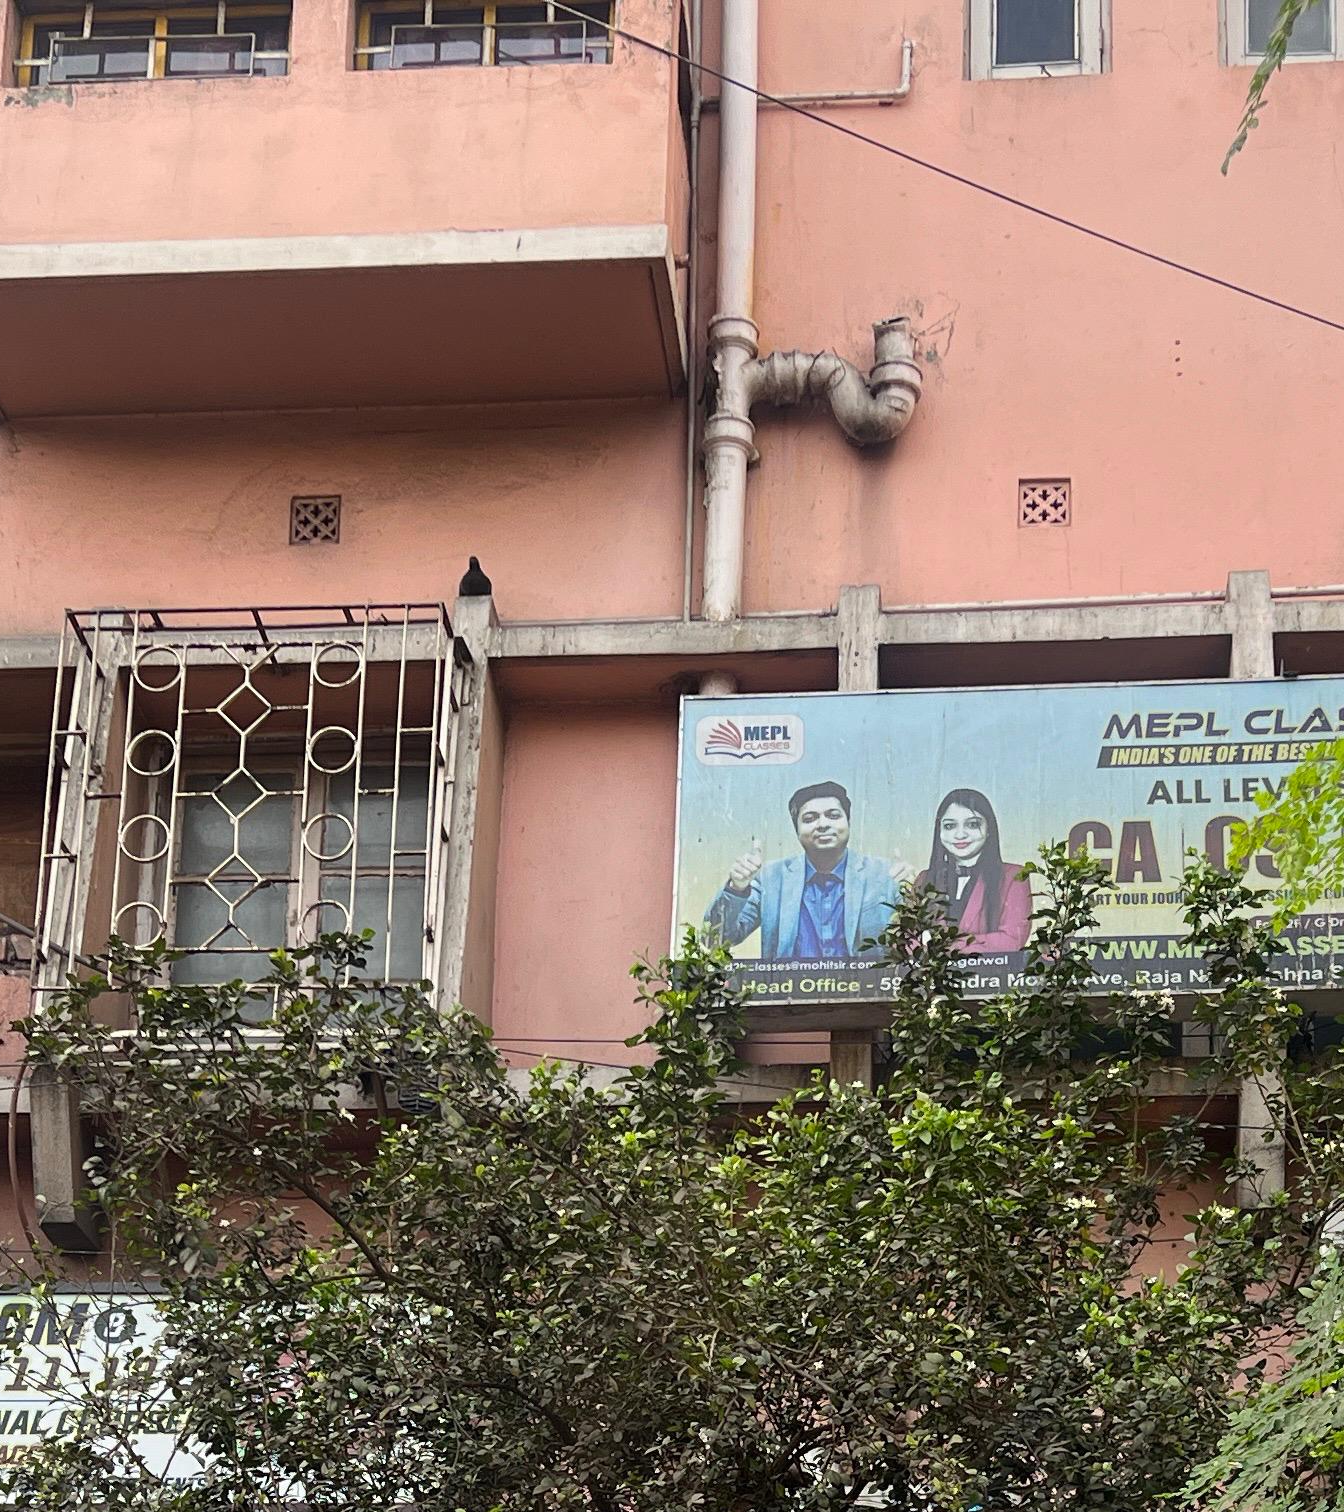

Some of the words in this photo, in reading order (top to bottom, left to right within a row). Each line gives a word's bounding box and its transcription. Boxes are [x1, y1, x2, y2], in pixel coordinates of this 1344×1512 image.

[744, 724, 792, 743] MEPL
[1102, 711, 1230, 740] MEPL
[743, 741, 791, 752] CLASSES
[1110, 745, 1177, 767] INDIA'S
[1179, 745, 1213, 765] ONE
[1216, 744, 1238, 763] OF
[1240, 744, 1273, 762] THE
[1275, 742, 1316, 761] BES
[1147, 779, 1211, 805] ALL
[1068, 820, 1163, 884] CA
[1115, 892, 1149, 905] YOUR
[742, 978, 794, 993] Head
[799, 977, 861, 993] Office
[1135, 969, 1182, 987] Raja
